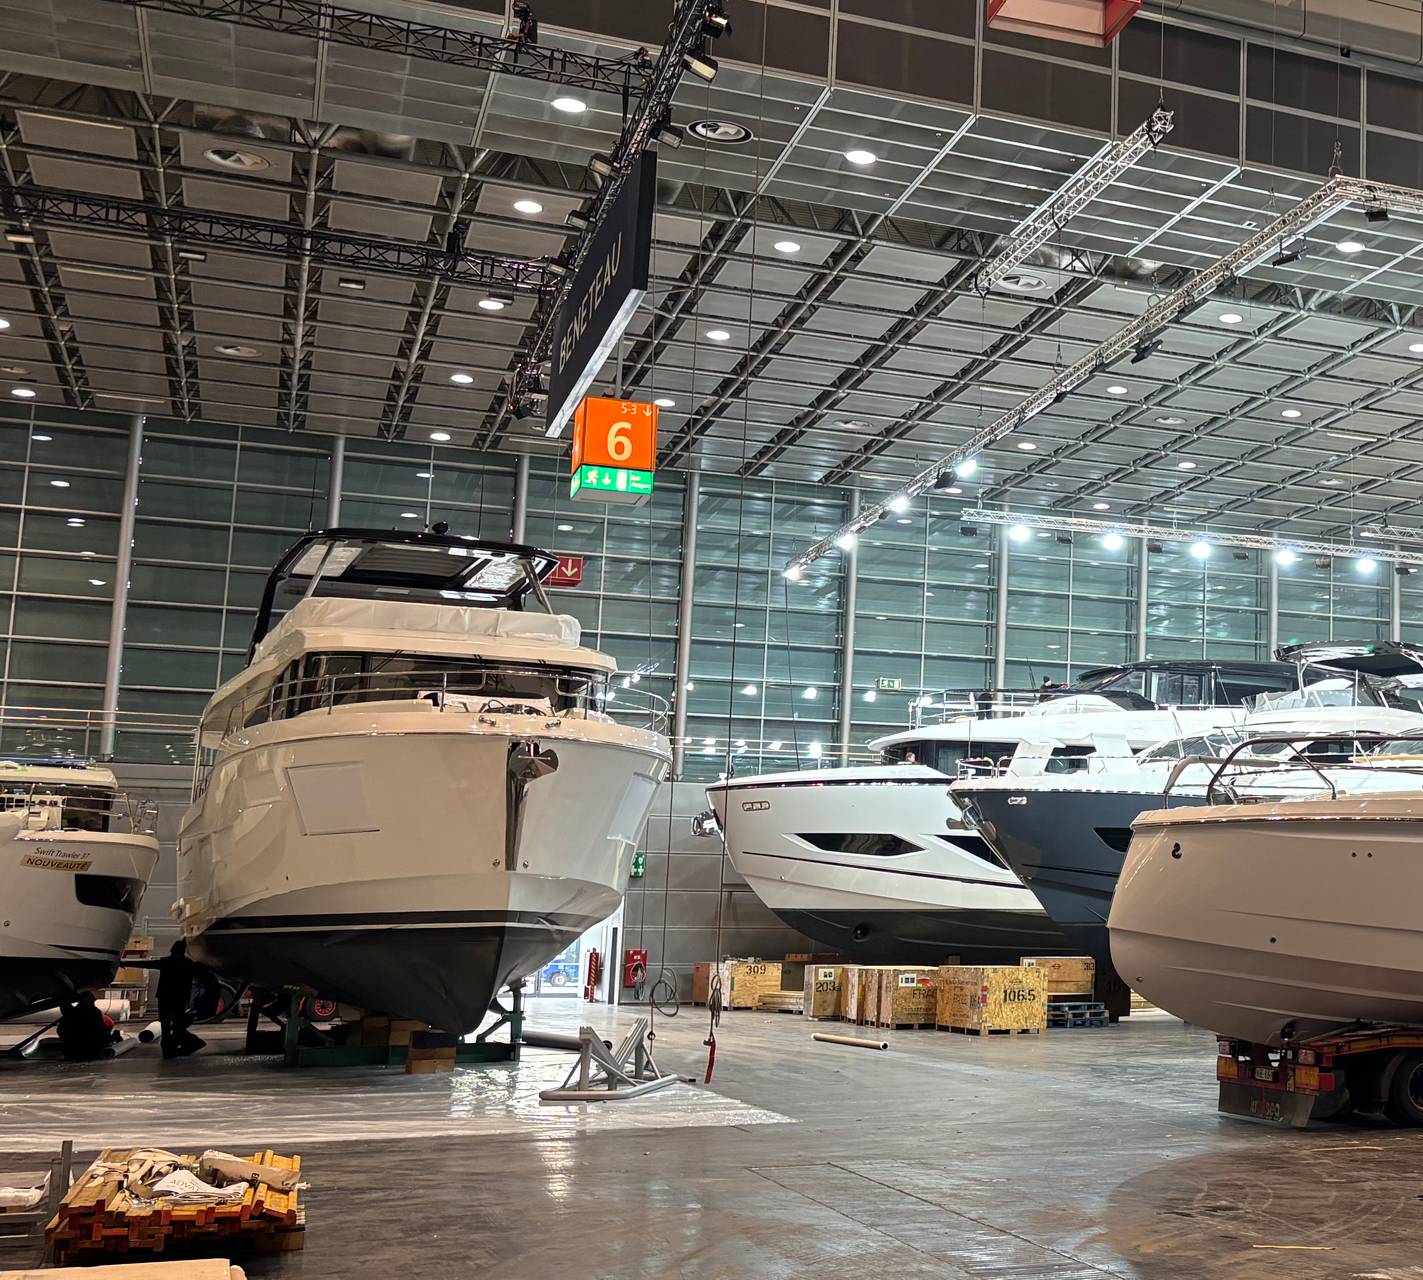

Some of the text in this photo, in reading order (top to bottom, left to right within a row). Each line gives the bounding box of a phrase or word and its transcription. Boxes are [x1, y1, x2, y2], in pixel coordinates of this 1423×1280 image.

[558, 231, 622, 375] BENETEAU
[620, 403, 638, 415] 5-3
[606, 421, 634, 462] 6
[34, 846, 55, 858] Swift
[55, 849, 80, 859] Trawler
[26, 857, 89, 870] NOUVEAUTÉ
[745, 965, 767, 975] 309
